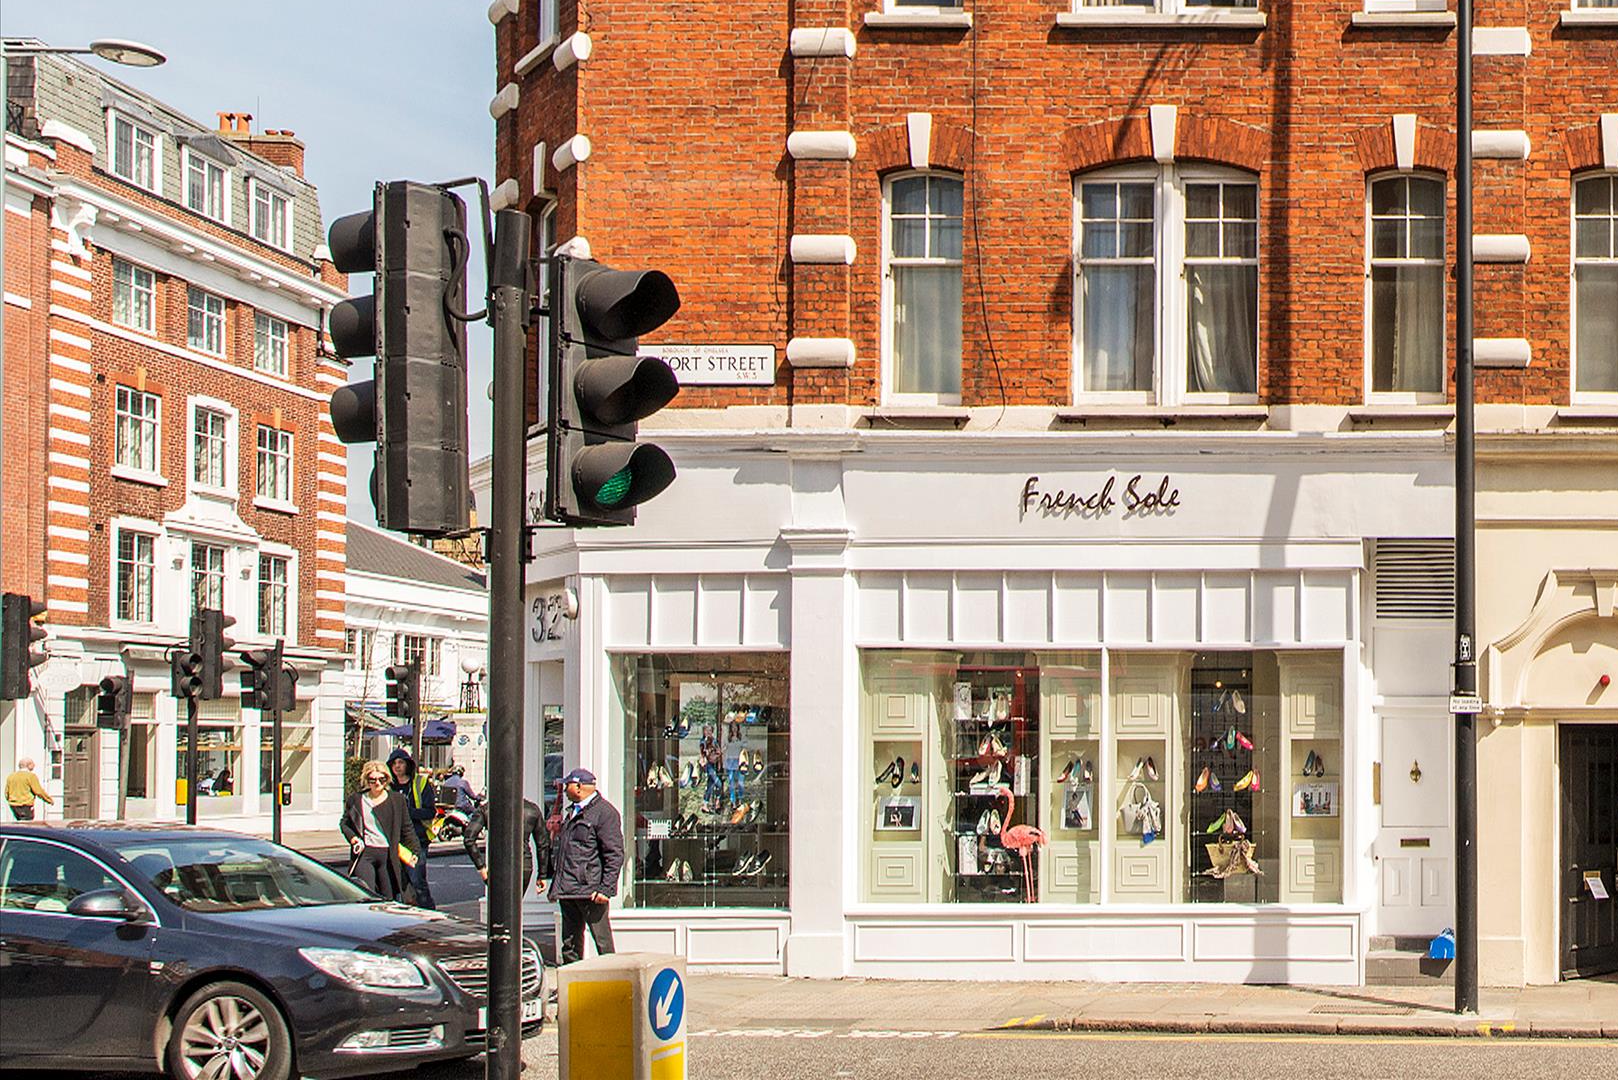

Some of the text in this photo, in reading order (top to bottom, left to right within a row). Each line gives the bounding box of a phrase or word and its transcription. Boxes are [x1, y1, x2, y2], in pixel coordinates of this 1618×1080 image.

[707, 356, 768, 371] STREET
[1022, 475, 1181, 513] French Sole
